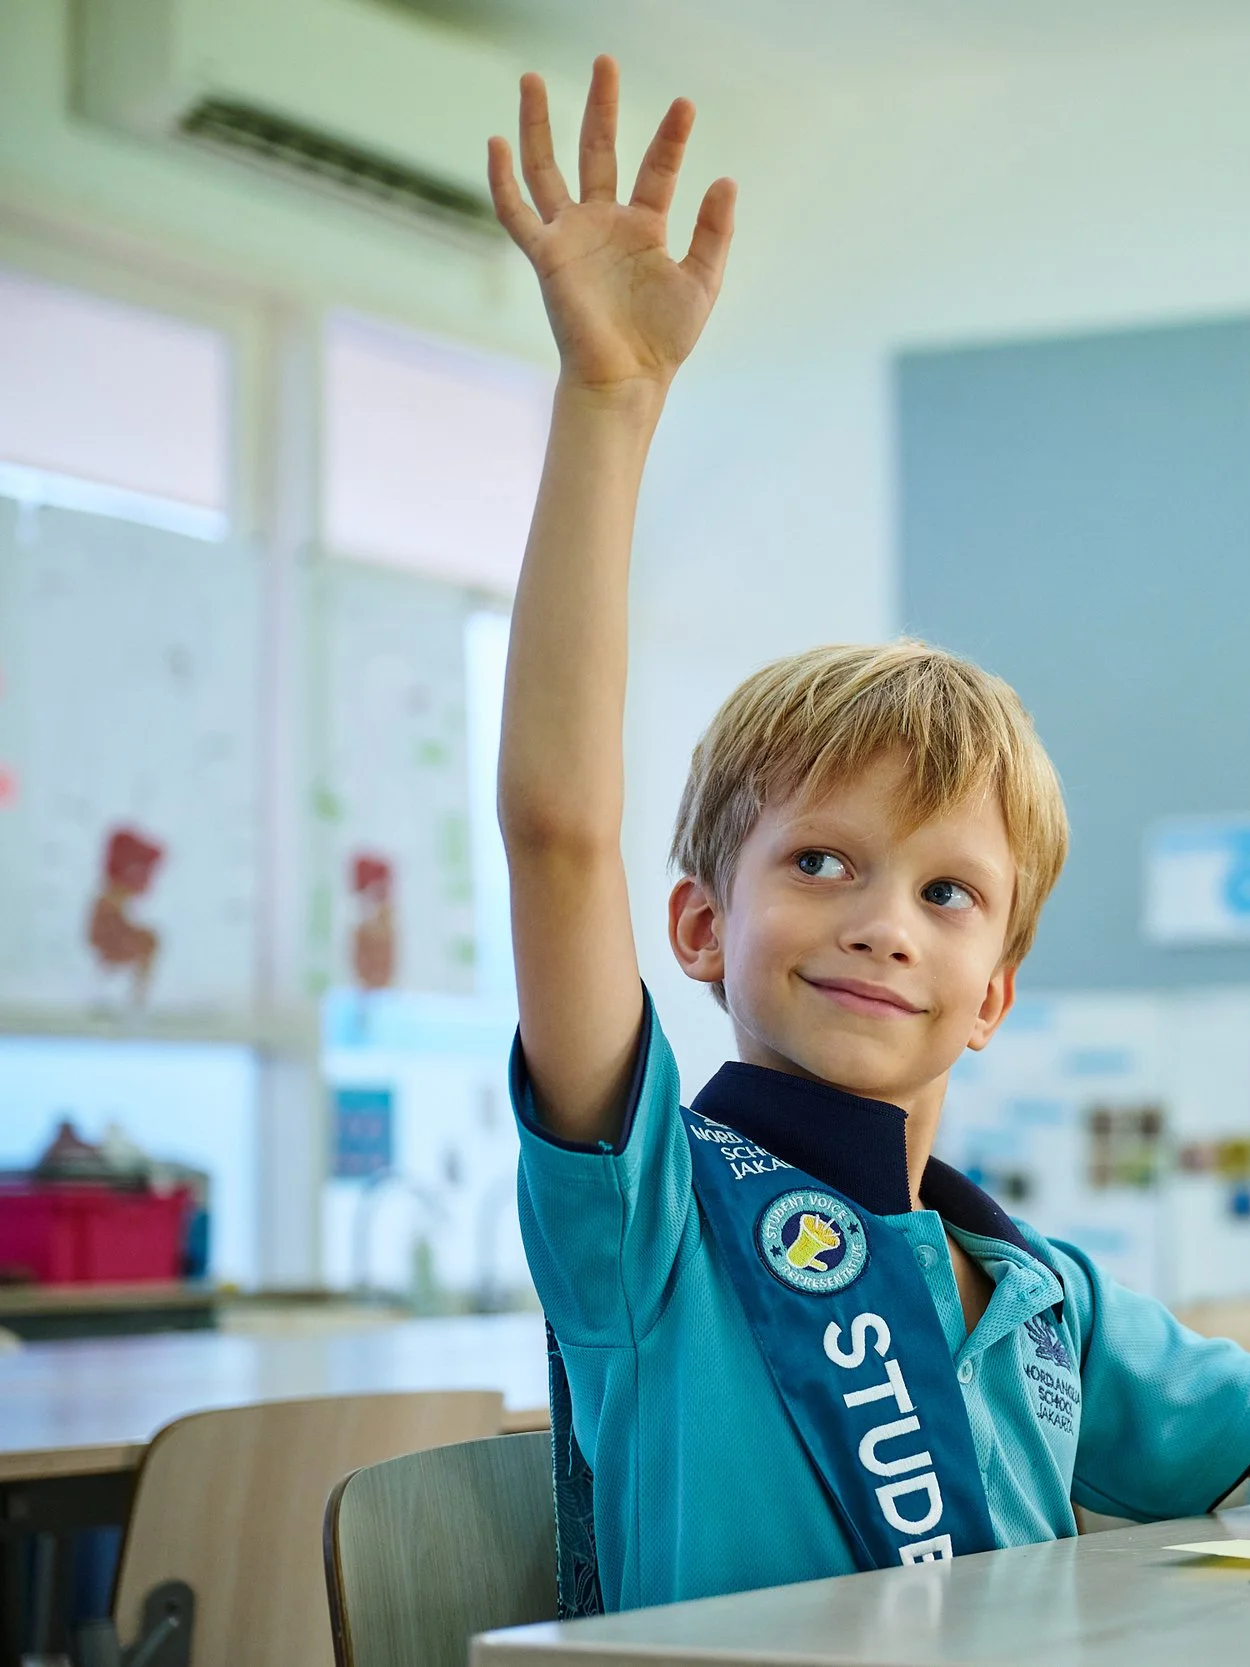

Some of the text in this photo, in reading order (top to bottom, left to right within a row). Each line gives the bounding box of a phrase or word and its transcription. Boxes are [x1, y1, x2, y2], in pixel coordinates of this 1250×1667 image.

[689, 1124, 743, 1144] NORD
[720, 1145, 778, 1160] SCH
[730, 1157, 796, 1180] JAKA
[767, 1193, 847, 1239] STUDENT VOICE
[782, 1242, 864, 1288] REPRESENTATIVE
[1022, 1363, 1054, 1389] NORD
[1038, 1385, 1073, 1418] SCHOOL
